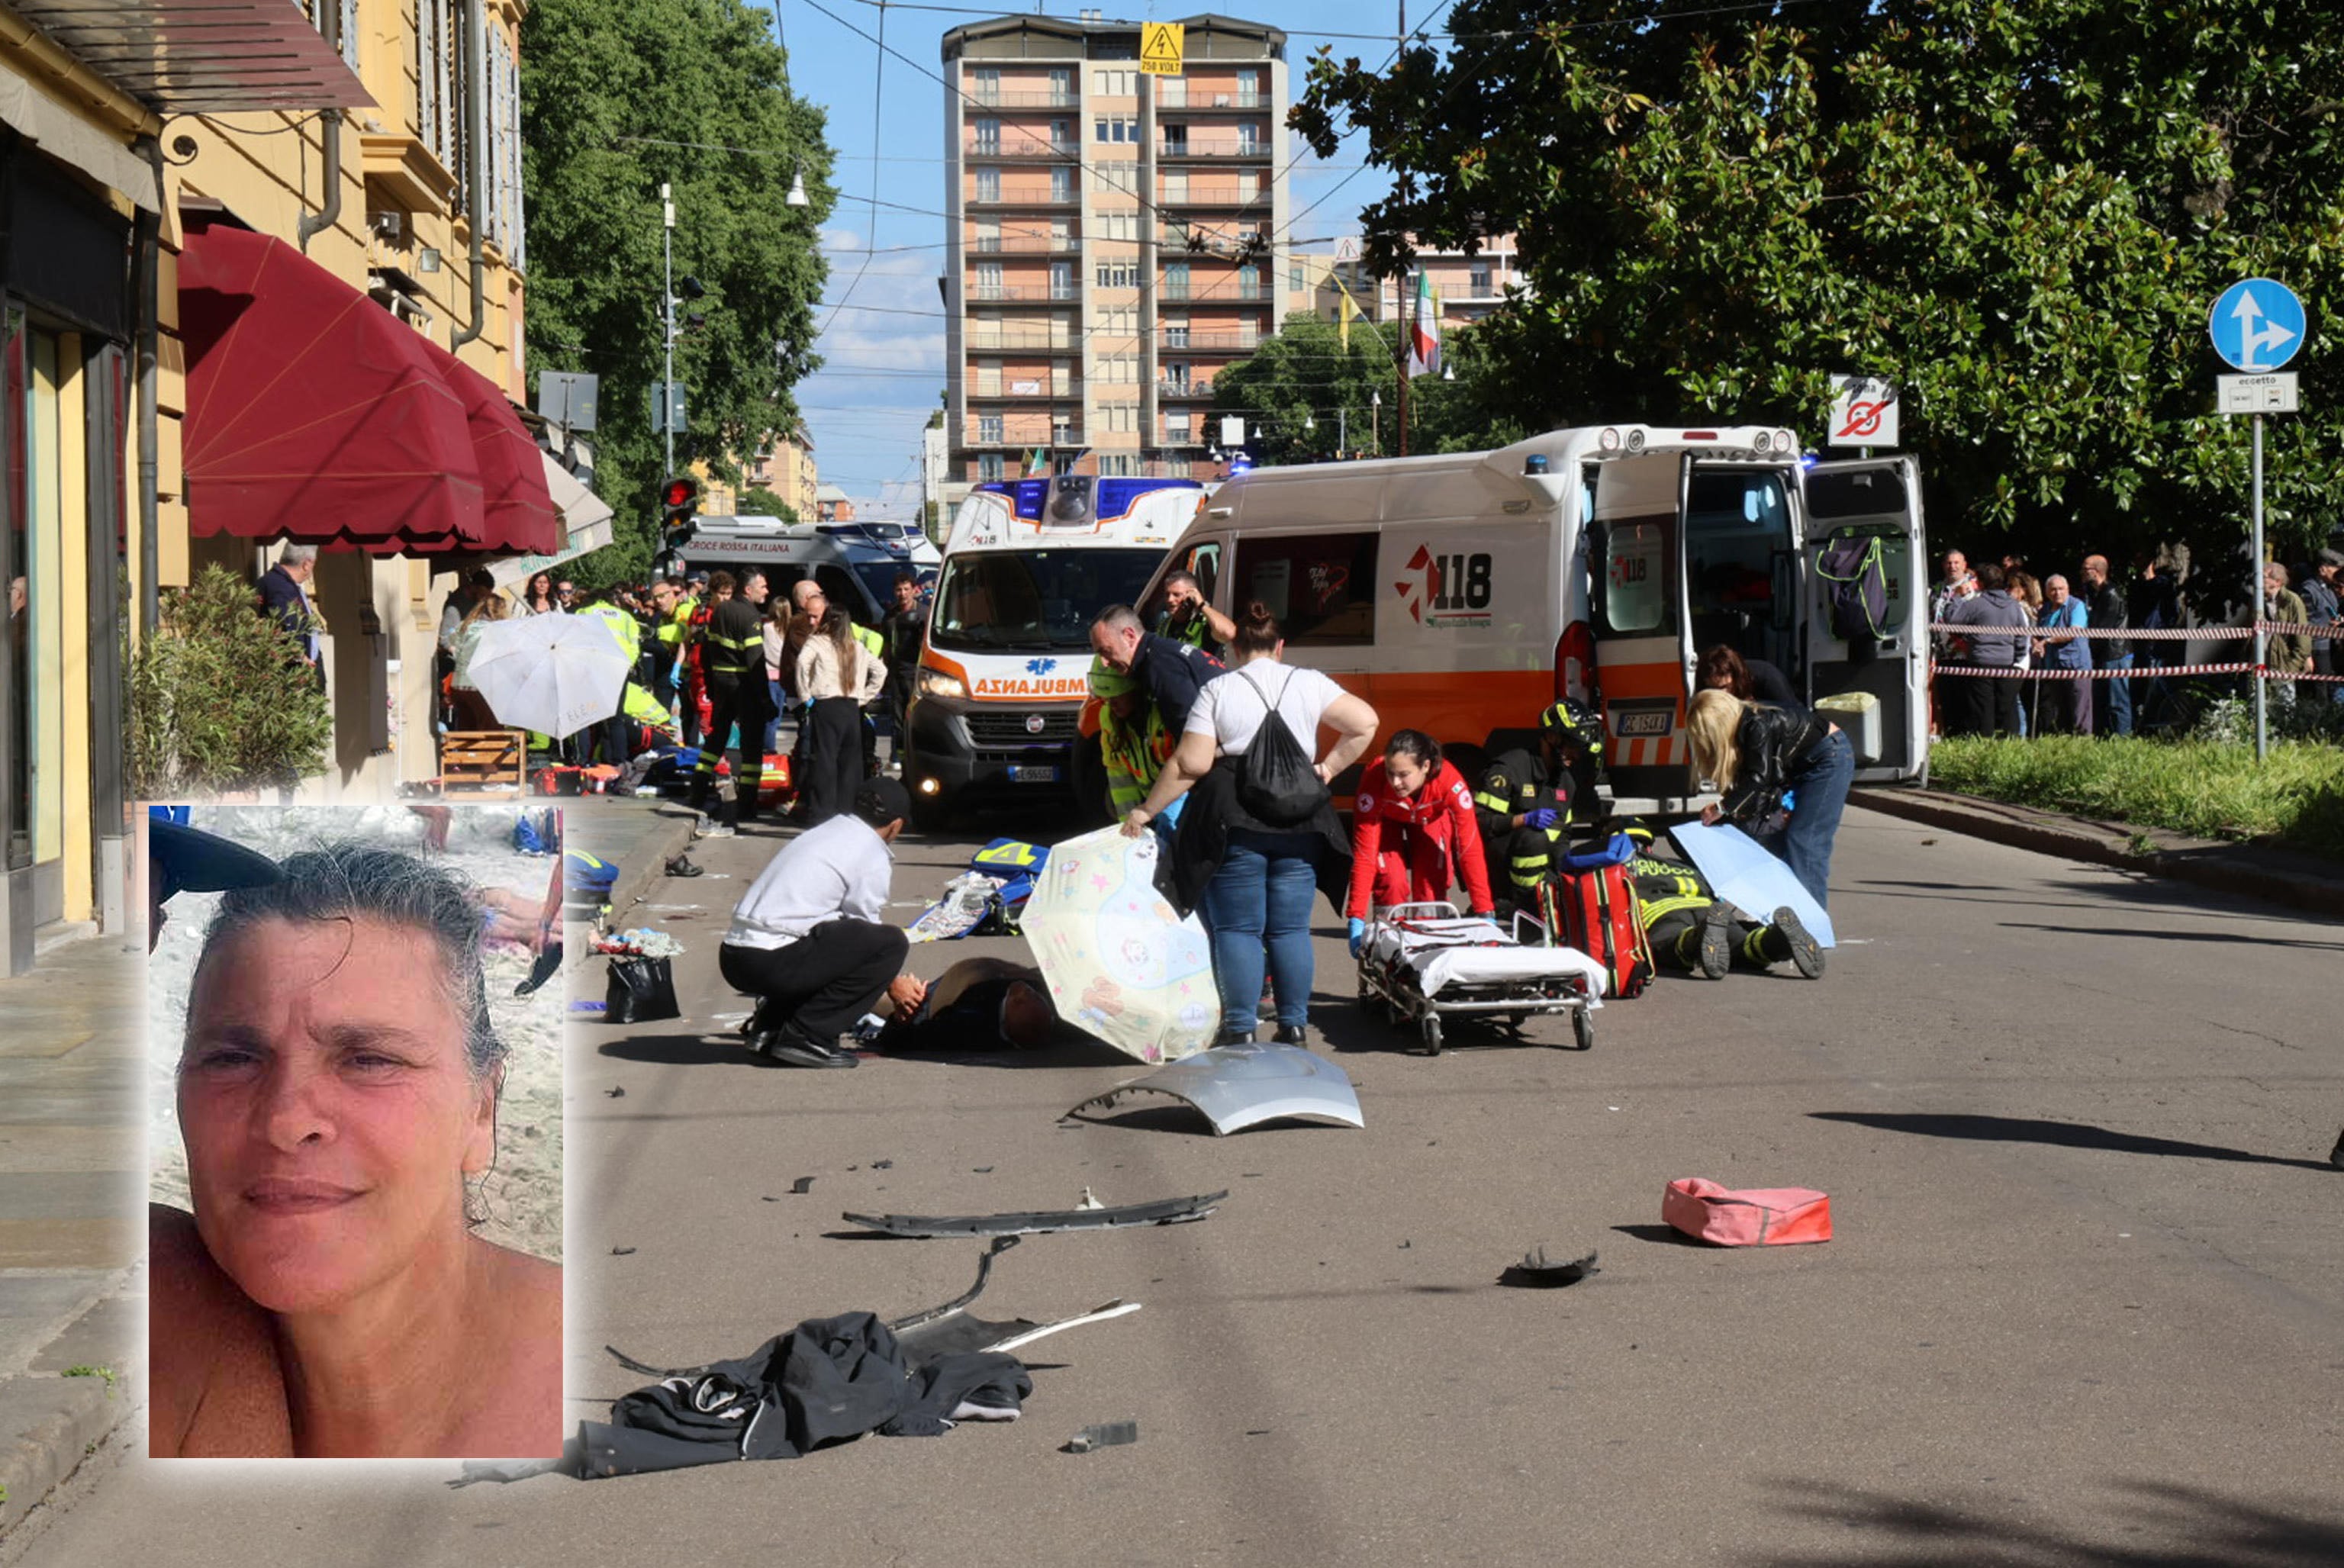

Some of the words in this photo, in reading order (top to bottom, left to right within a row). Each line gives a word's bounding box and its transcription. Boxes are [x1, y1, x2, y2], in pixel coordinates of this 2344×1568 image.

[1142, 62, 1157, 71] 750
[1159, 63, 1180, 72] VOLT
[2239, 377, 2276, 385] eccetto
[688, 541, 716, 550] CROCE
[720, 542, 748, 551] ROSSA
[750, 543, 790, 553] ITALIANA
[1626, 558, 1647, 583] 118
[1434, 553, 1492, 610] 118
[1638, 867, 1694, 877] FUOCO
